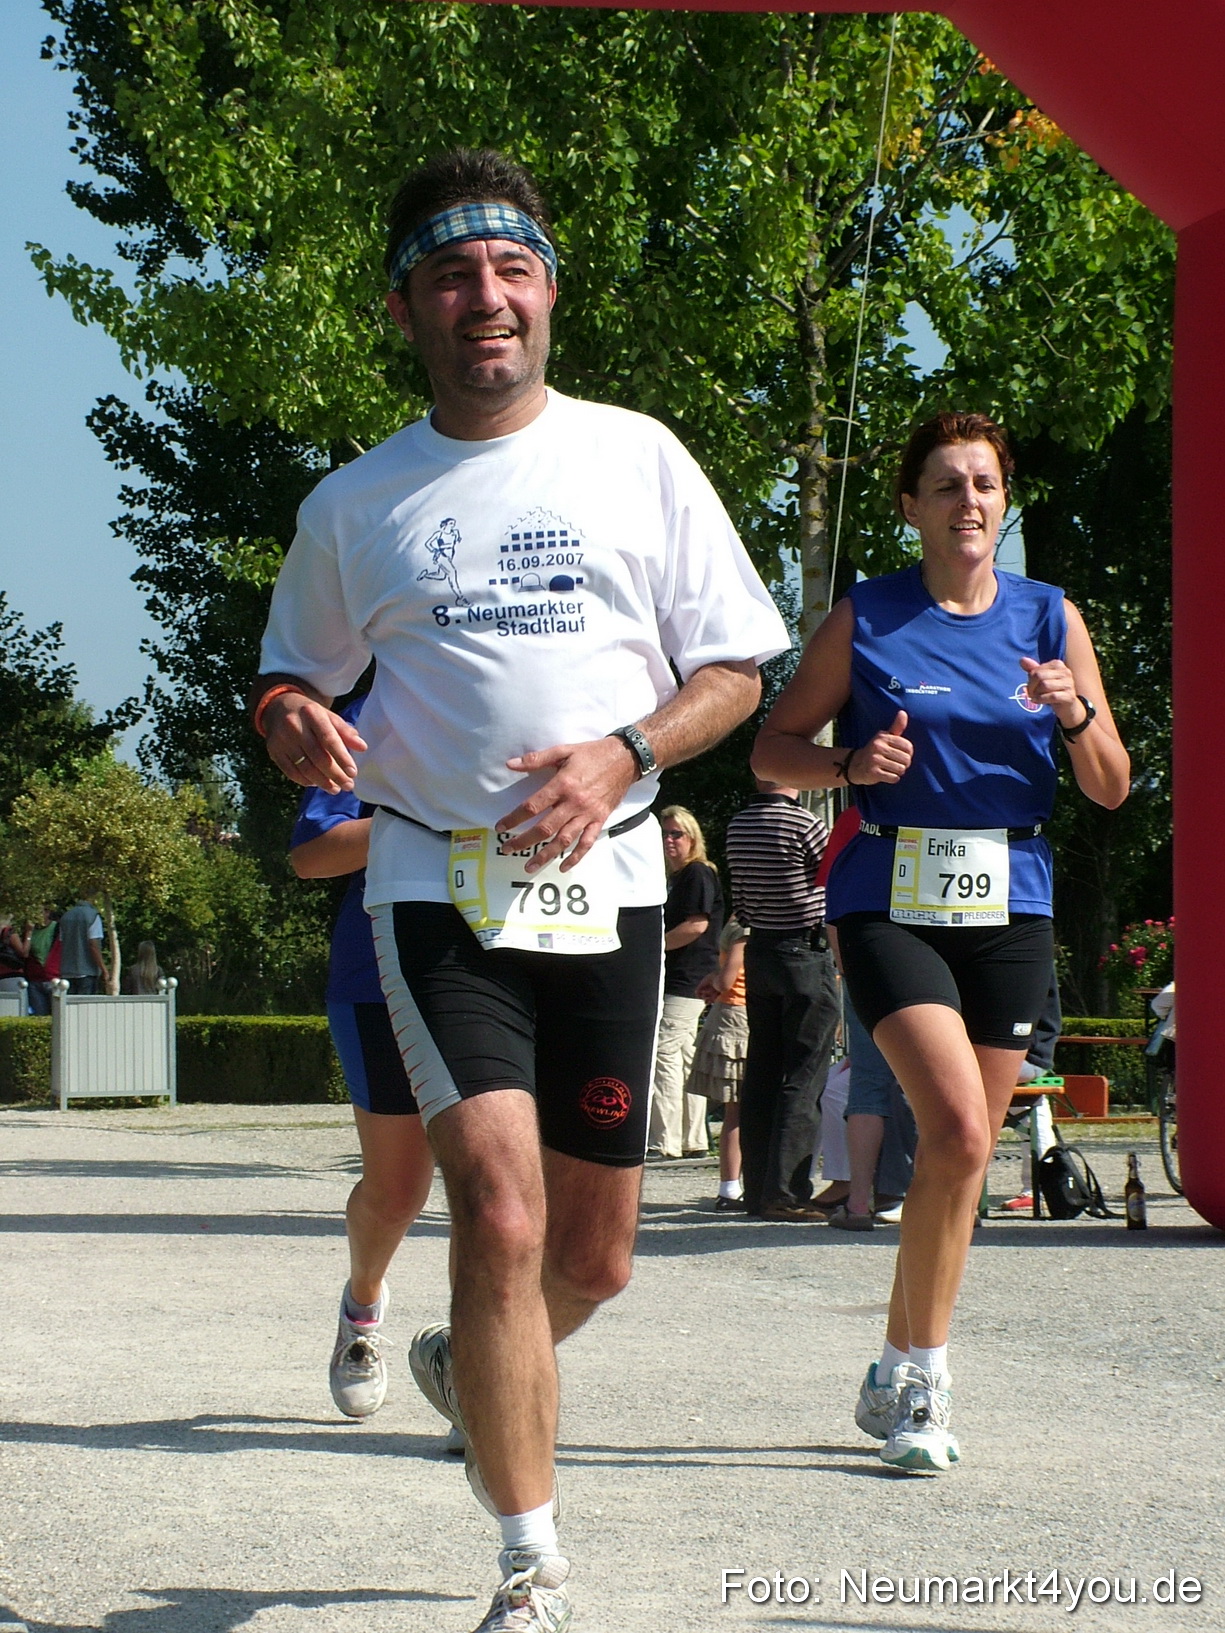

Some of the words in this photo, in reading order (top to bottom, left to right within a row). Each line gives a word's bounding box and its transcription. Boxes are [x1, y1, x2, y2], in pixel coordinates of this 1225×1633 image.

[497, 553, 585, 572] 16.09.2007
[432, 605, 462, 627] 8.
[467, 600, 584, 623] Neumarkter
[497, 616, 586, 637] Stadtlauf
[927, 838, 966, 857] Erika
[899, 864, 907, 878] D
[938, 873, 991, 899] 799
[511, 881, 590, 916] 798
[964, 911, 1006, 920] PFLEIDERER
